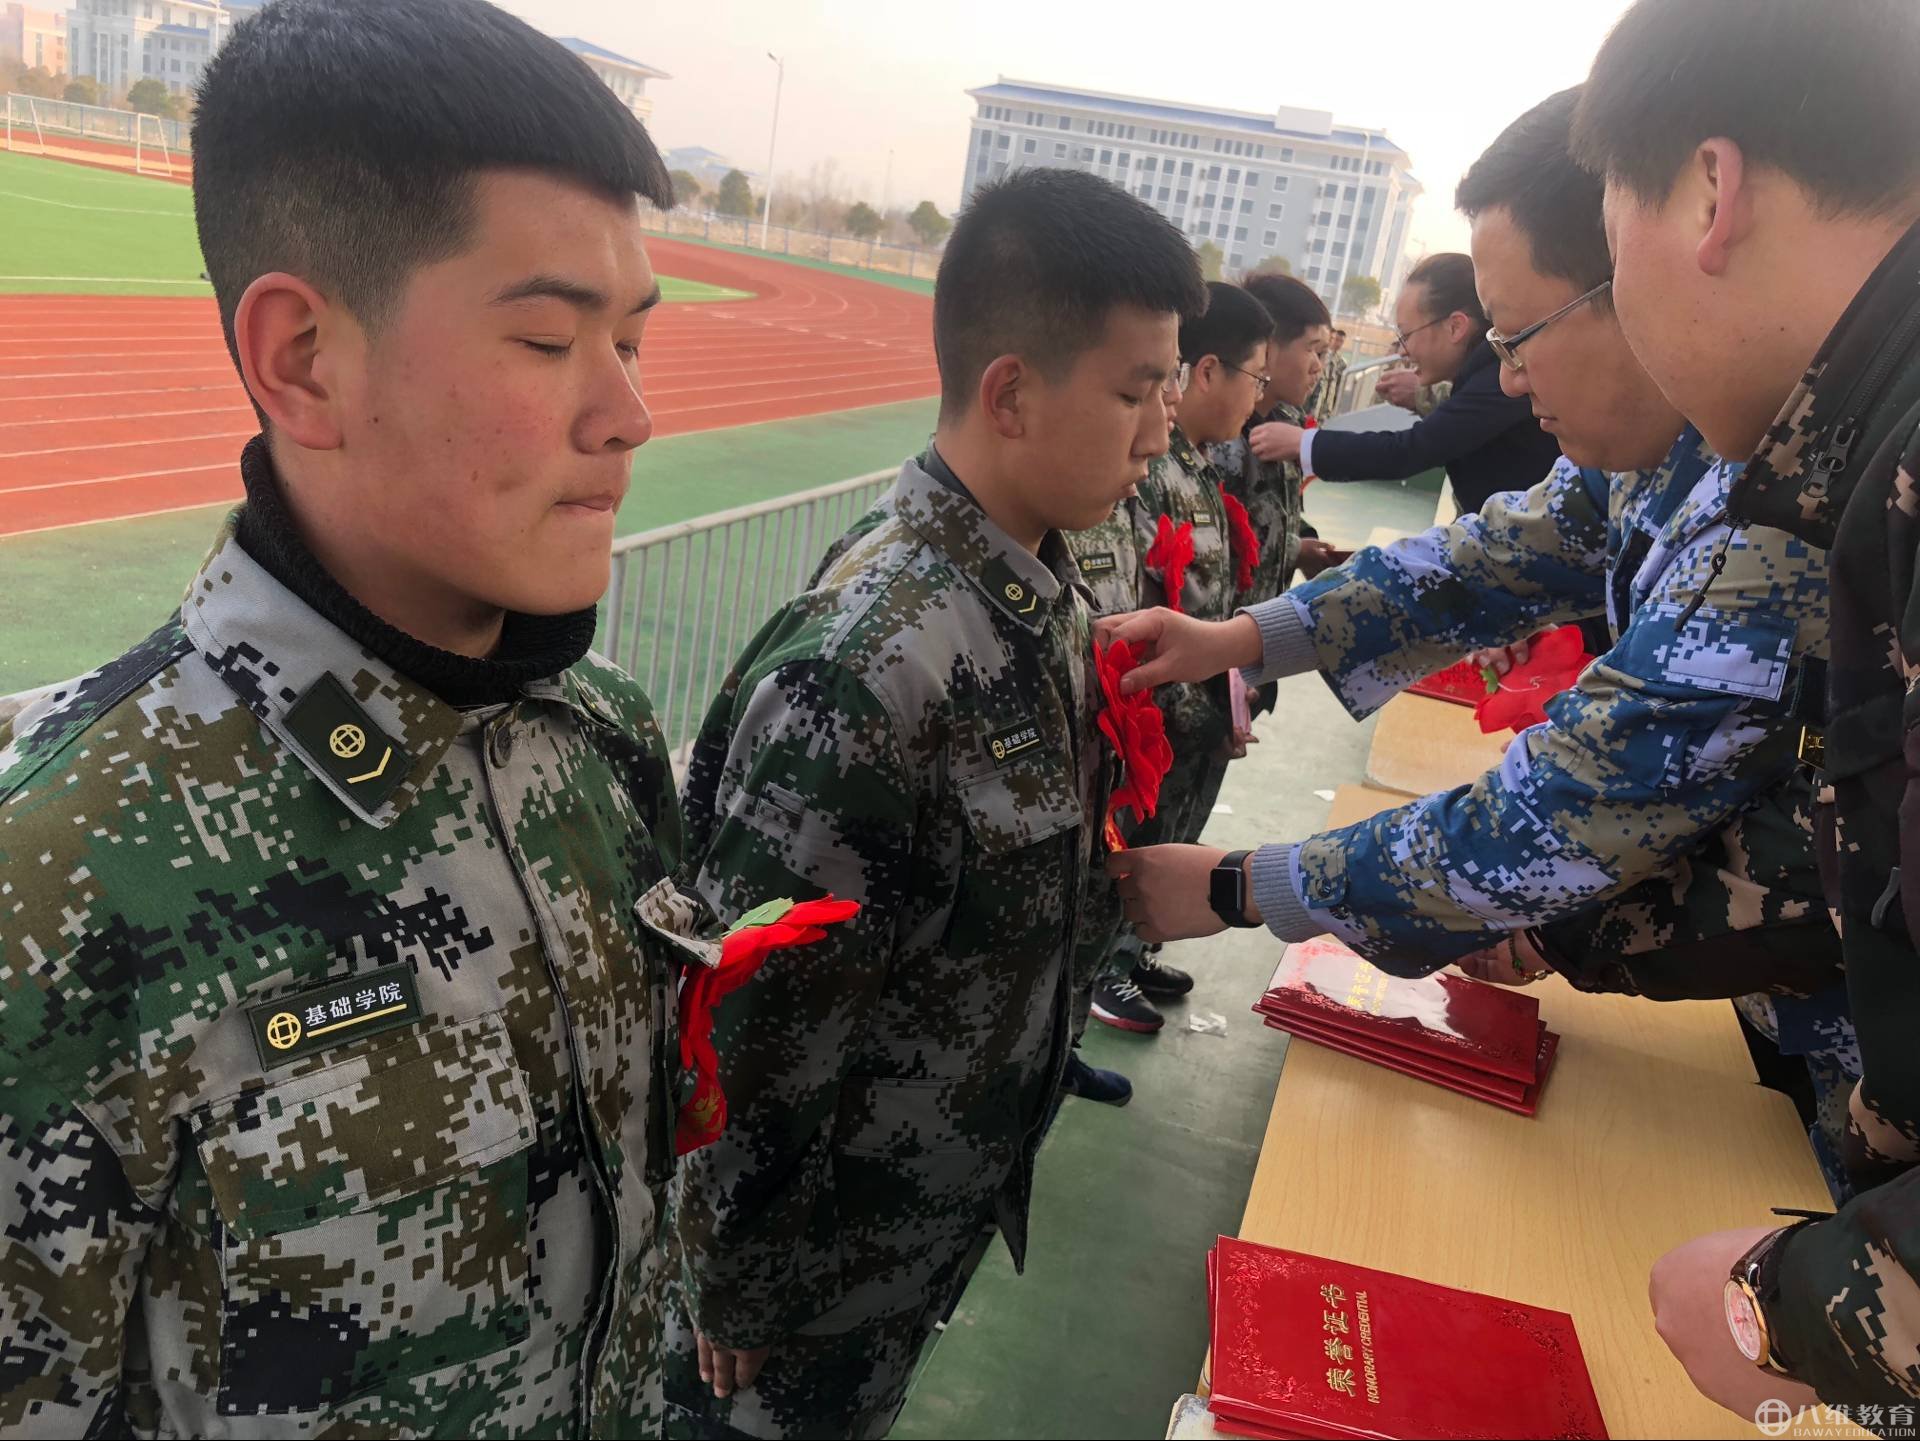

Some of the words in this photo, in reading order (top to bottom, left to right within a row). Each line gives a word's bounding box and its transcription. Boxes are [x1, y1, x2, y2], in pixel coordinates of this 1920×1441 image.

[304, 982, 404, 1028] 基础学院
[1319, 1283, 1357, 1398] 荣誉证书
[1362, 1346, 1381, 1404] HONORARY
